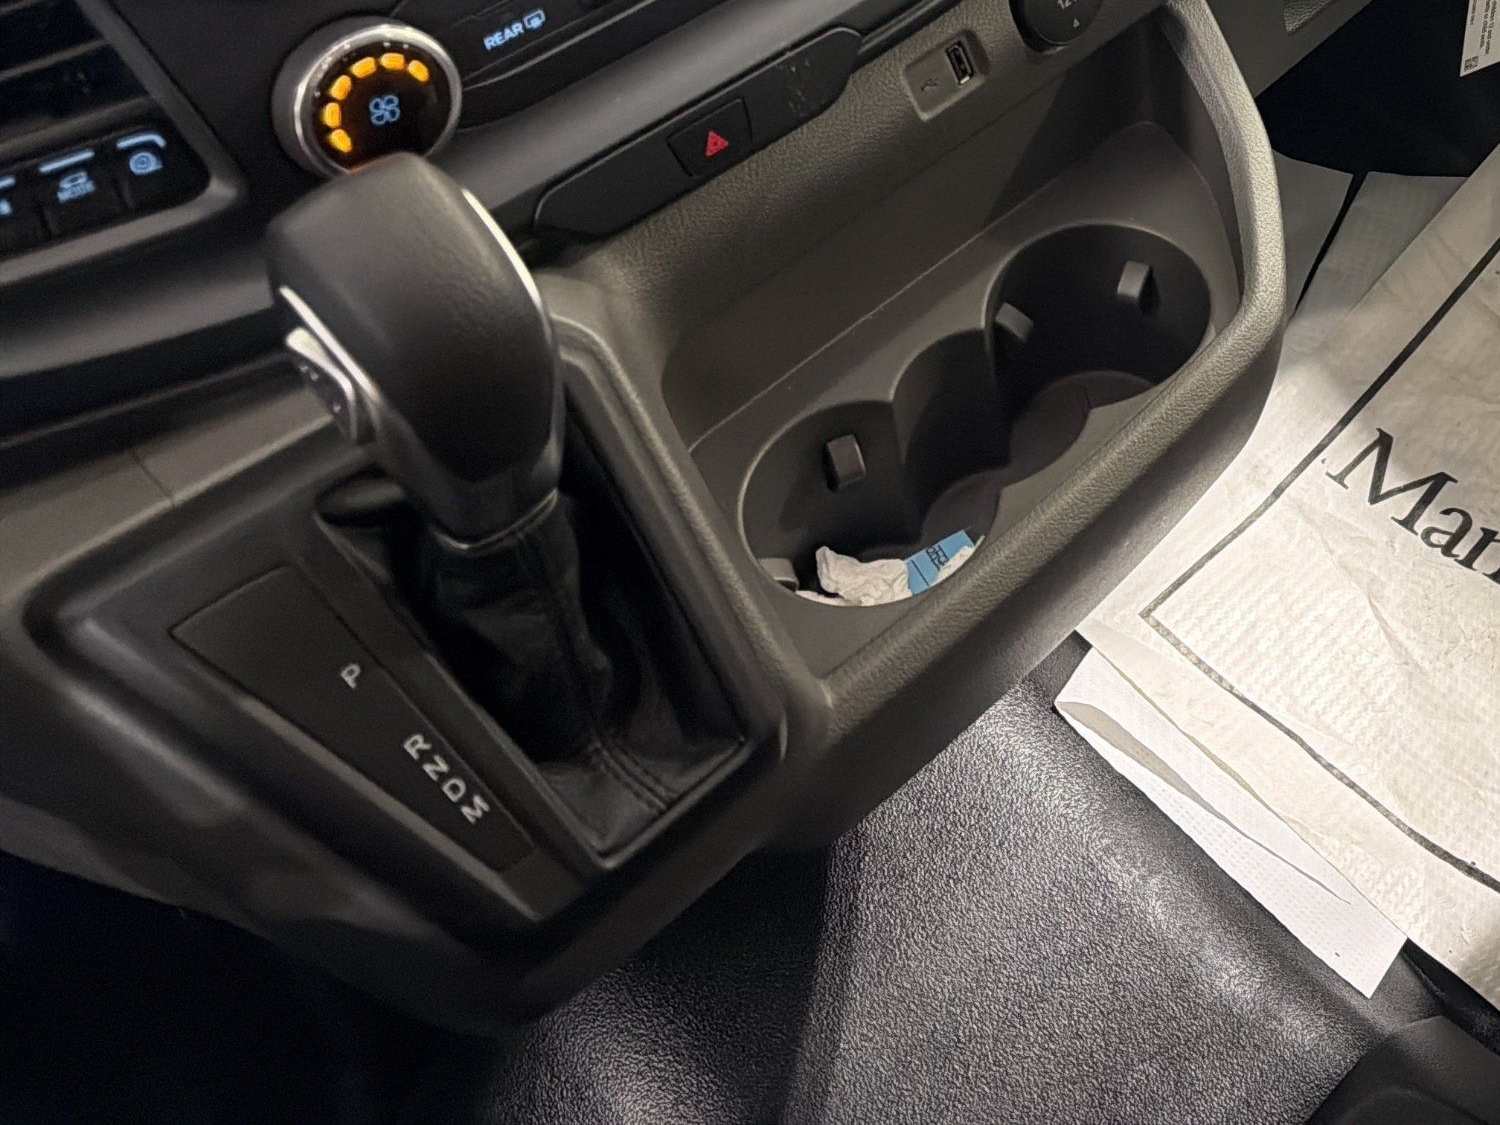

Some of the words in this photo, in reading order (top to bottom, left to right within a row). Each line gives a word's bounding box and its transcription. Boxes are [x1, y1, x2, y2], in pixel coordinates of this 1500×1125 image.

[483, 22, 524, 51] REAR
[340, 663, 361, 689] P
[403, 733, 432, 760] R
[422, 754, 449, 781] N
[441, 778, 467, 803] D
[460, 796, 490, 824] M
